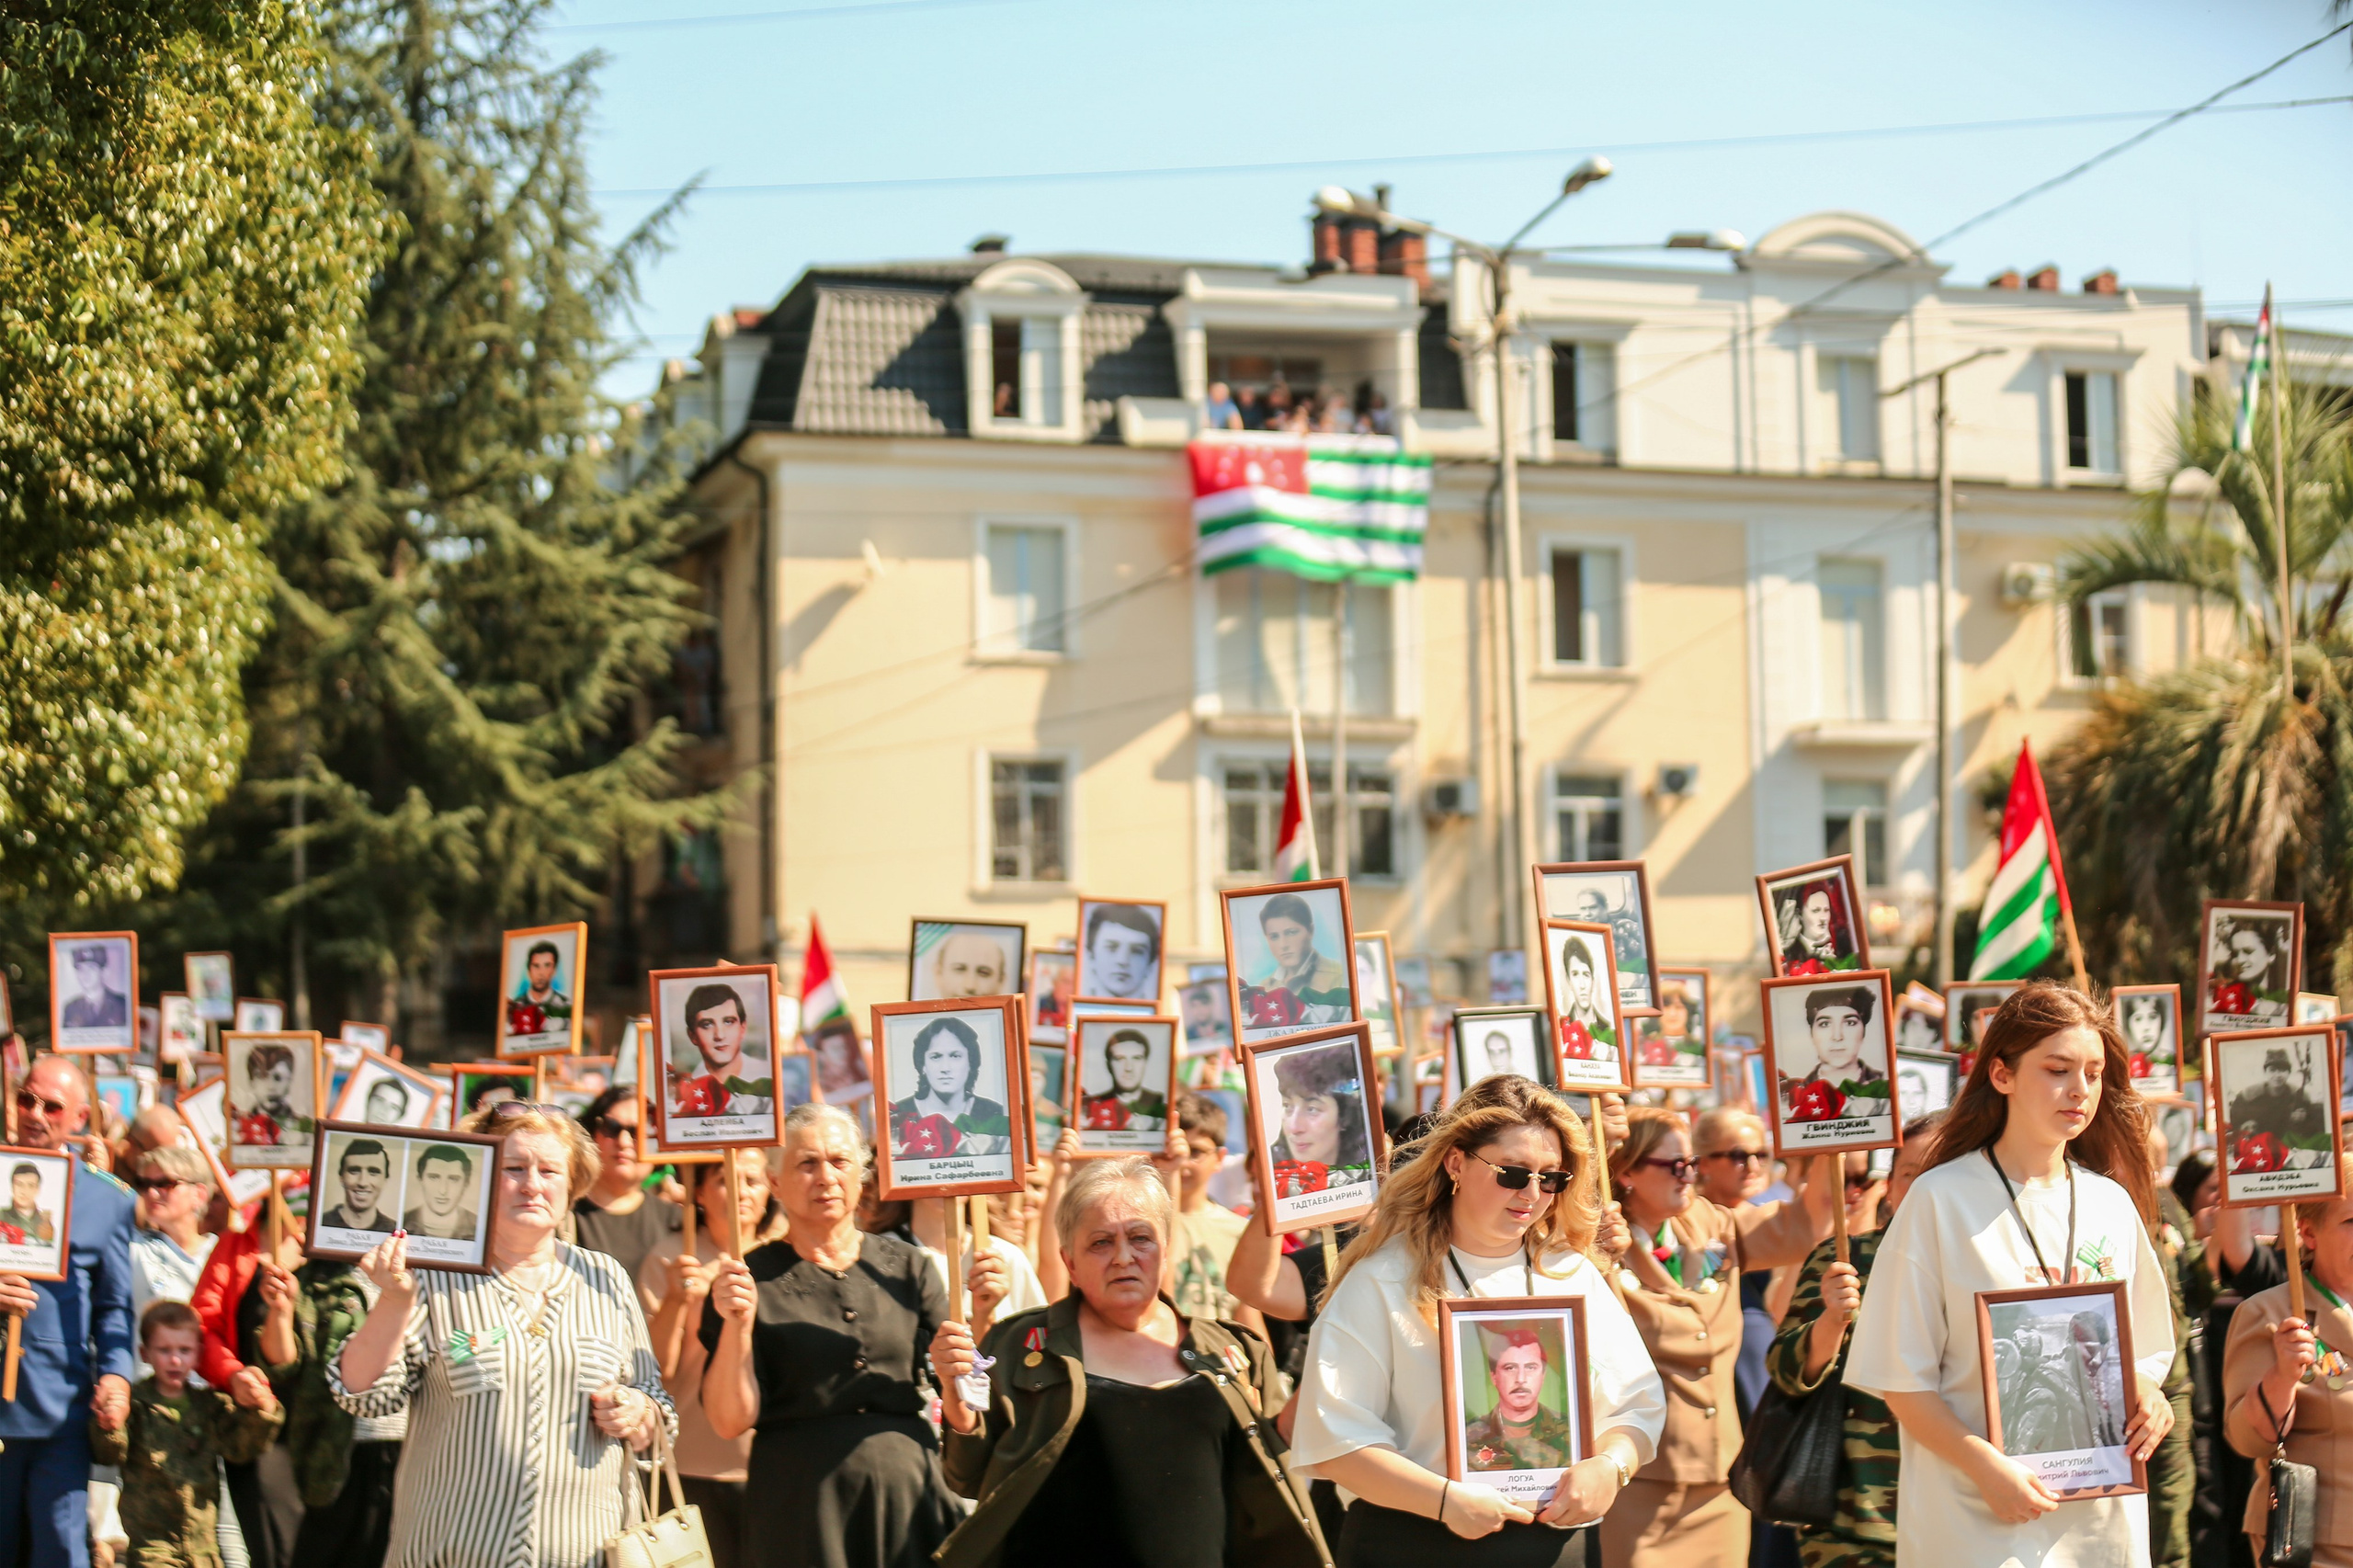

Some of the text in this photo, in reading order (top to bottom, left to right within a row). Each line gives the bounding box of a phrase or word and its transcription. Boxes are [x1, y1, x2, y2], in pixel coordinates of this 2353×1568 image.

[700, 1118, 745, 1127] АДЛЕЙБА
[1806, 1119, 1870, 1131] ГВИНДЖИЯ
[719, 1128, 763, 1136] Иванович
[1802, 1131, 1832, 1140] Жанна
[929, 1160, 974, 1169] БАРЦЫЦ
[900, 1169, 1004, 1183] Ирина Сафарбеевна
[2259, 1173, 2301, 1182] АВИДЗБА
[1290, 1189, 1363, 1210] ТАДТАЕВА ИРИНА
[2042, 1457, 2093, 1469] САНГУЛИЯ
[2070, 1469, 2109, 1477] Львович
